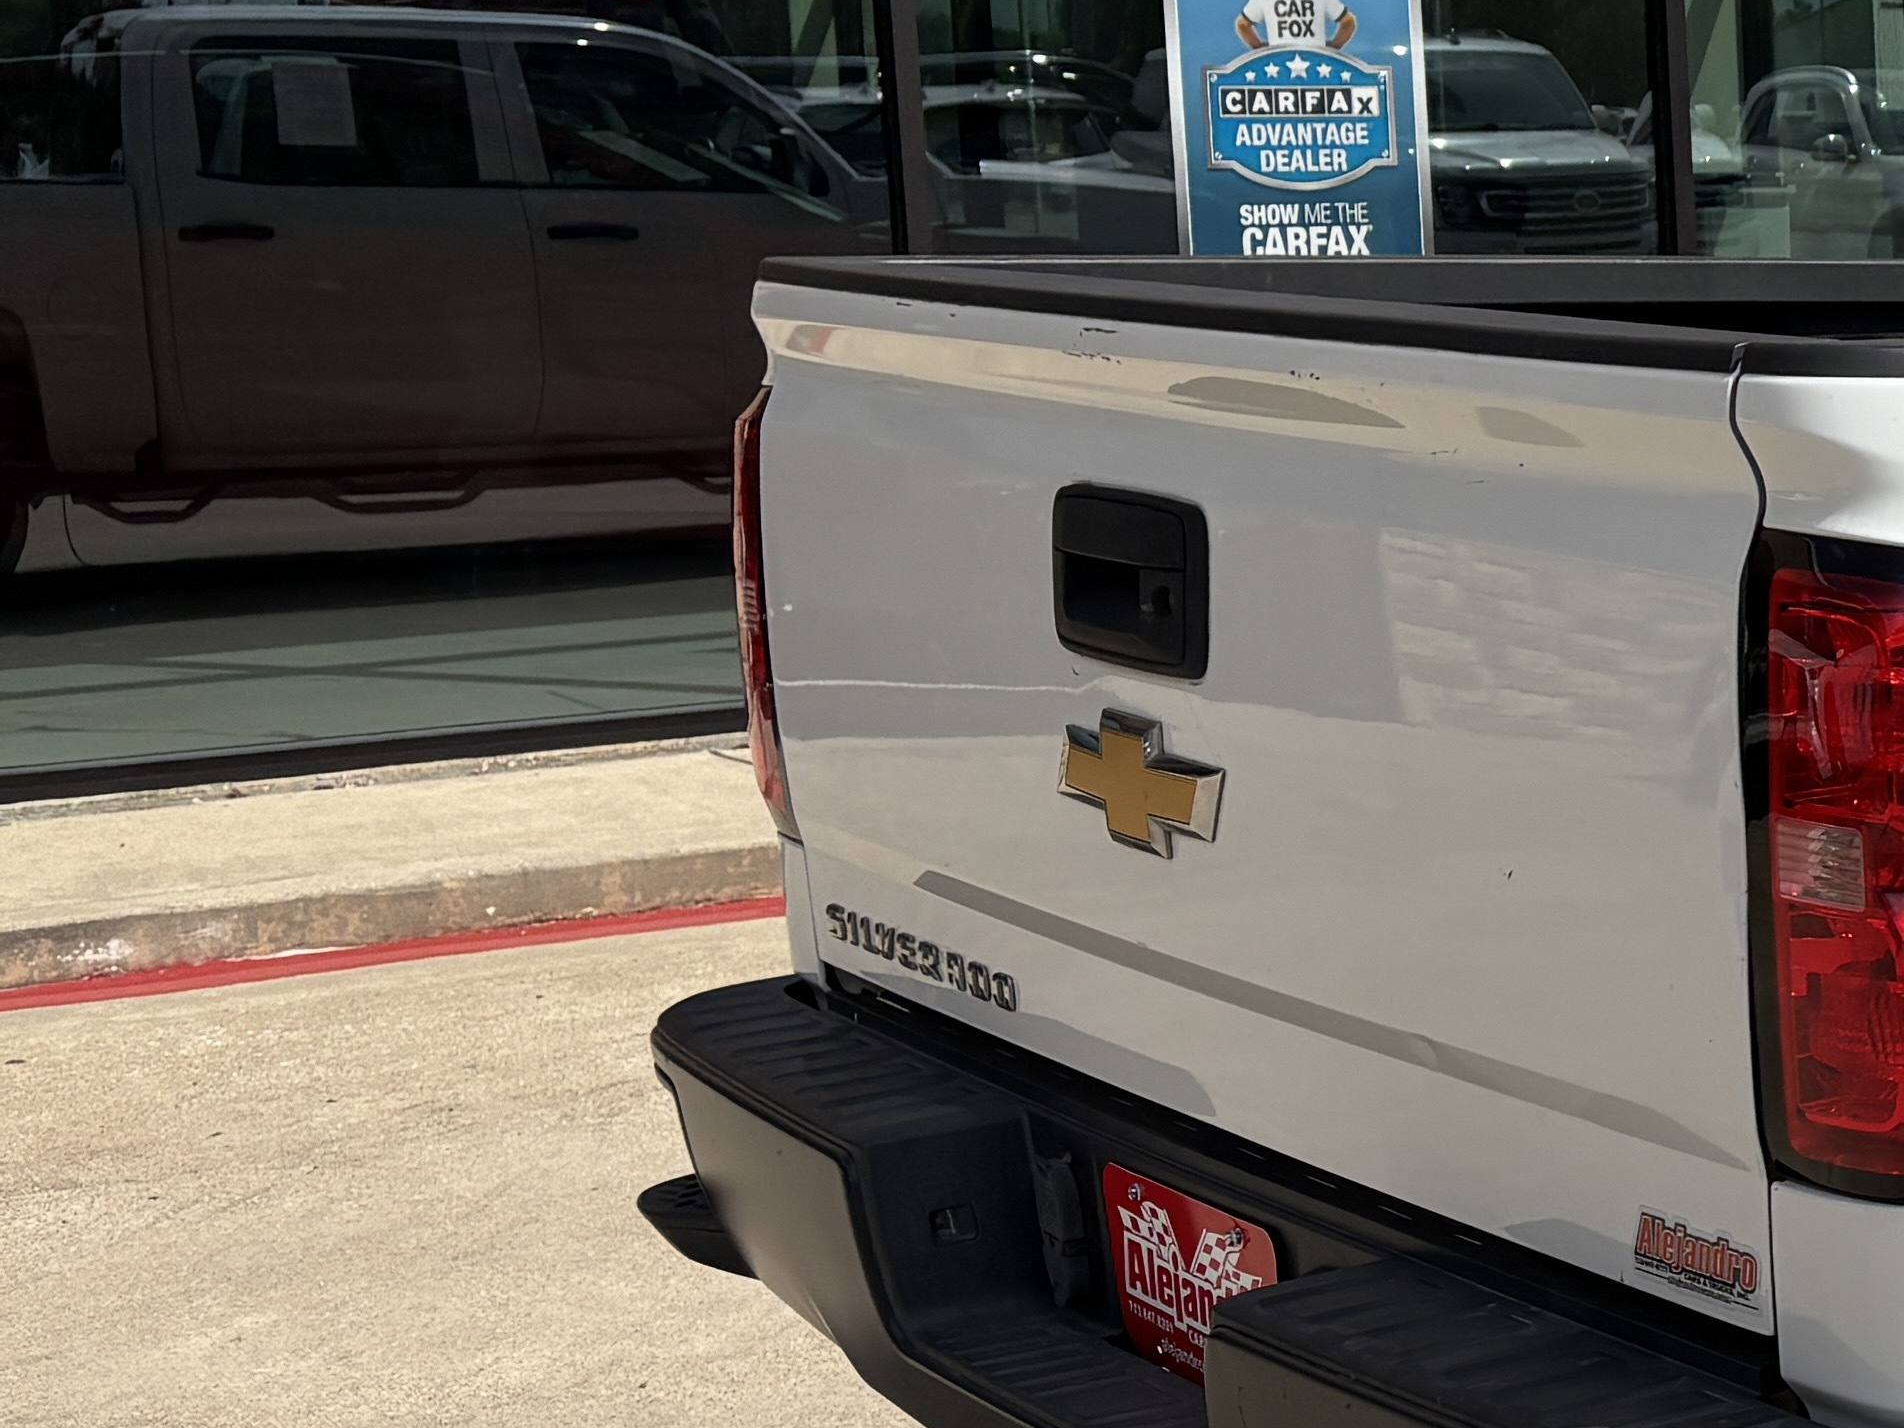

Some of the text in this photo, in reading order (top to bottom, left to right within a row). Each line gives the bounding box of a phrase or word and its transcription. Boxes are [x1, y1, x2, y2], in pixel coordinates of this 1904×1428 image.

[1274, 0, 1315, 18] CAR
[1277, 20, 1315, 38] FOX
[1223, 89, 1377, 115] CARFAX
[1236, 123, 1370, 146] ADVANTAGE
[1260, 150, 1348, 172] DEALER
[1240, 202, 1369, 226] SHOW ME THE
[1242, 226, 1371, 256] CARFAX
[826, 903, 1017, 1012] SILVERADO
[1635, 1213, 1757, 1293] Alejandro
